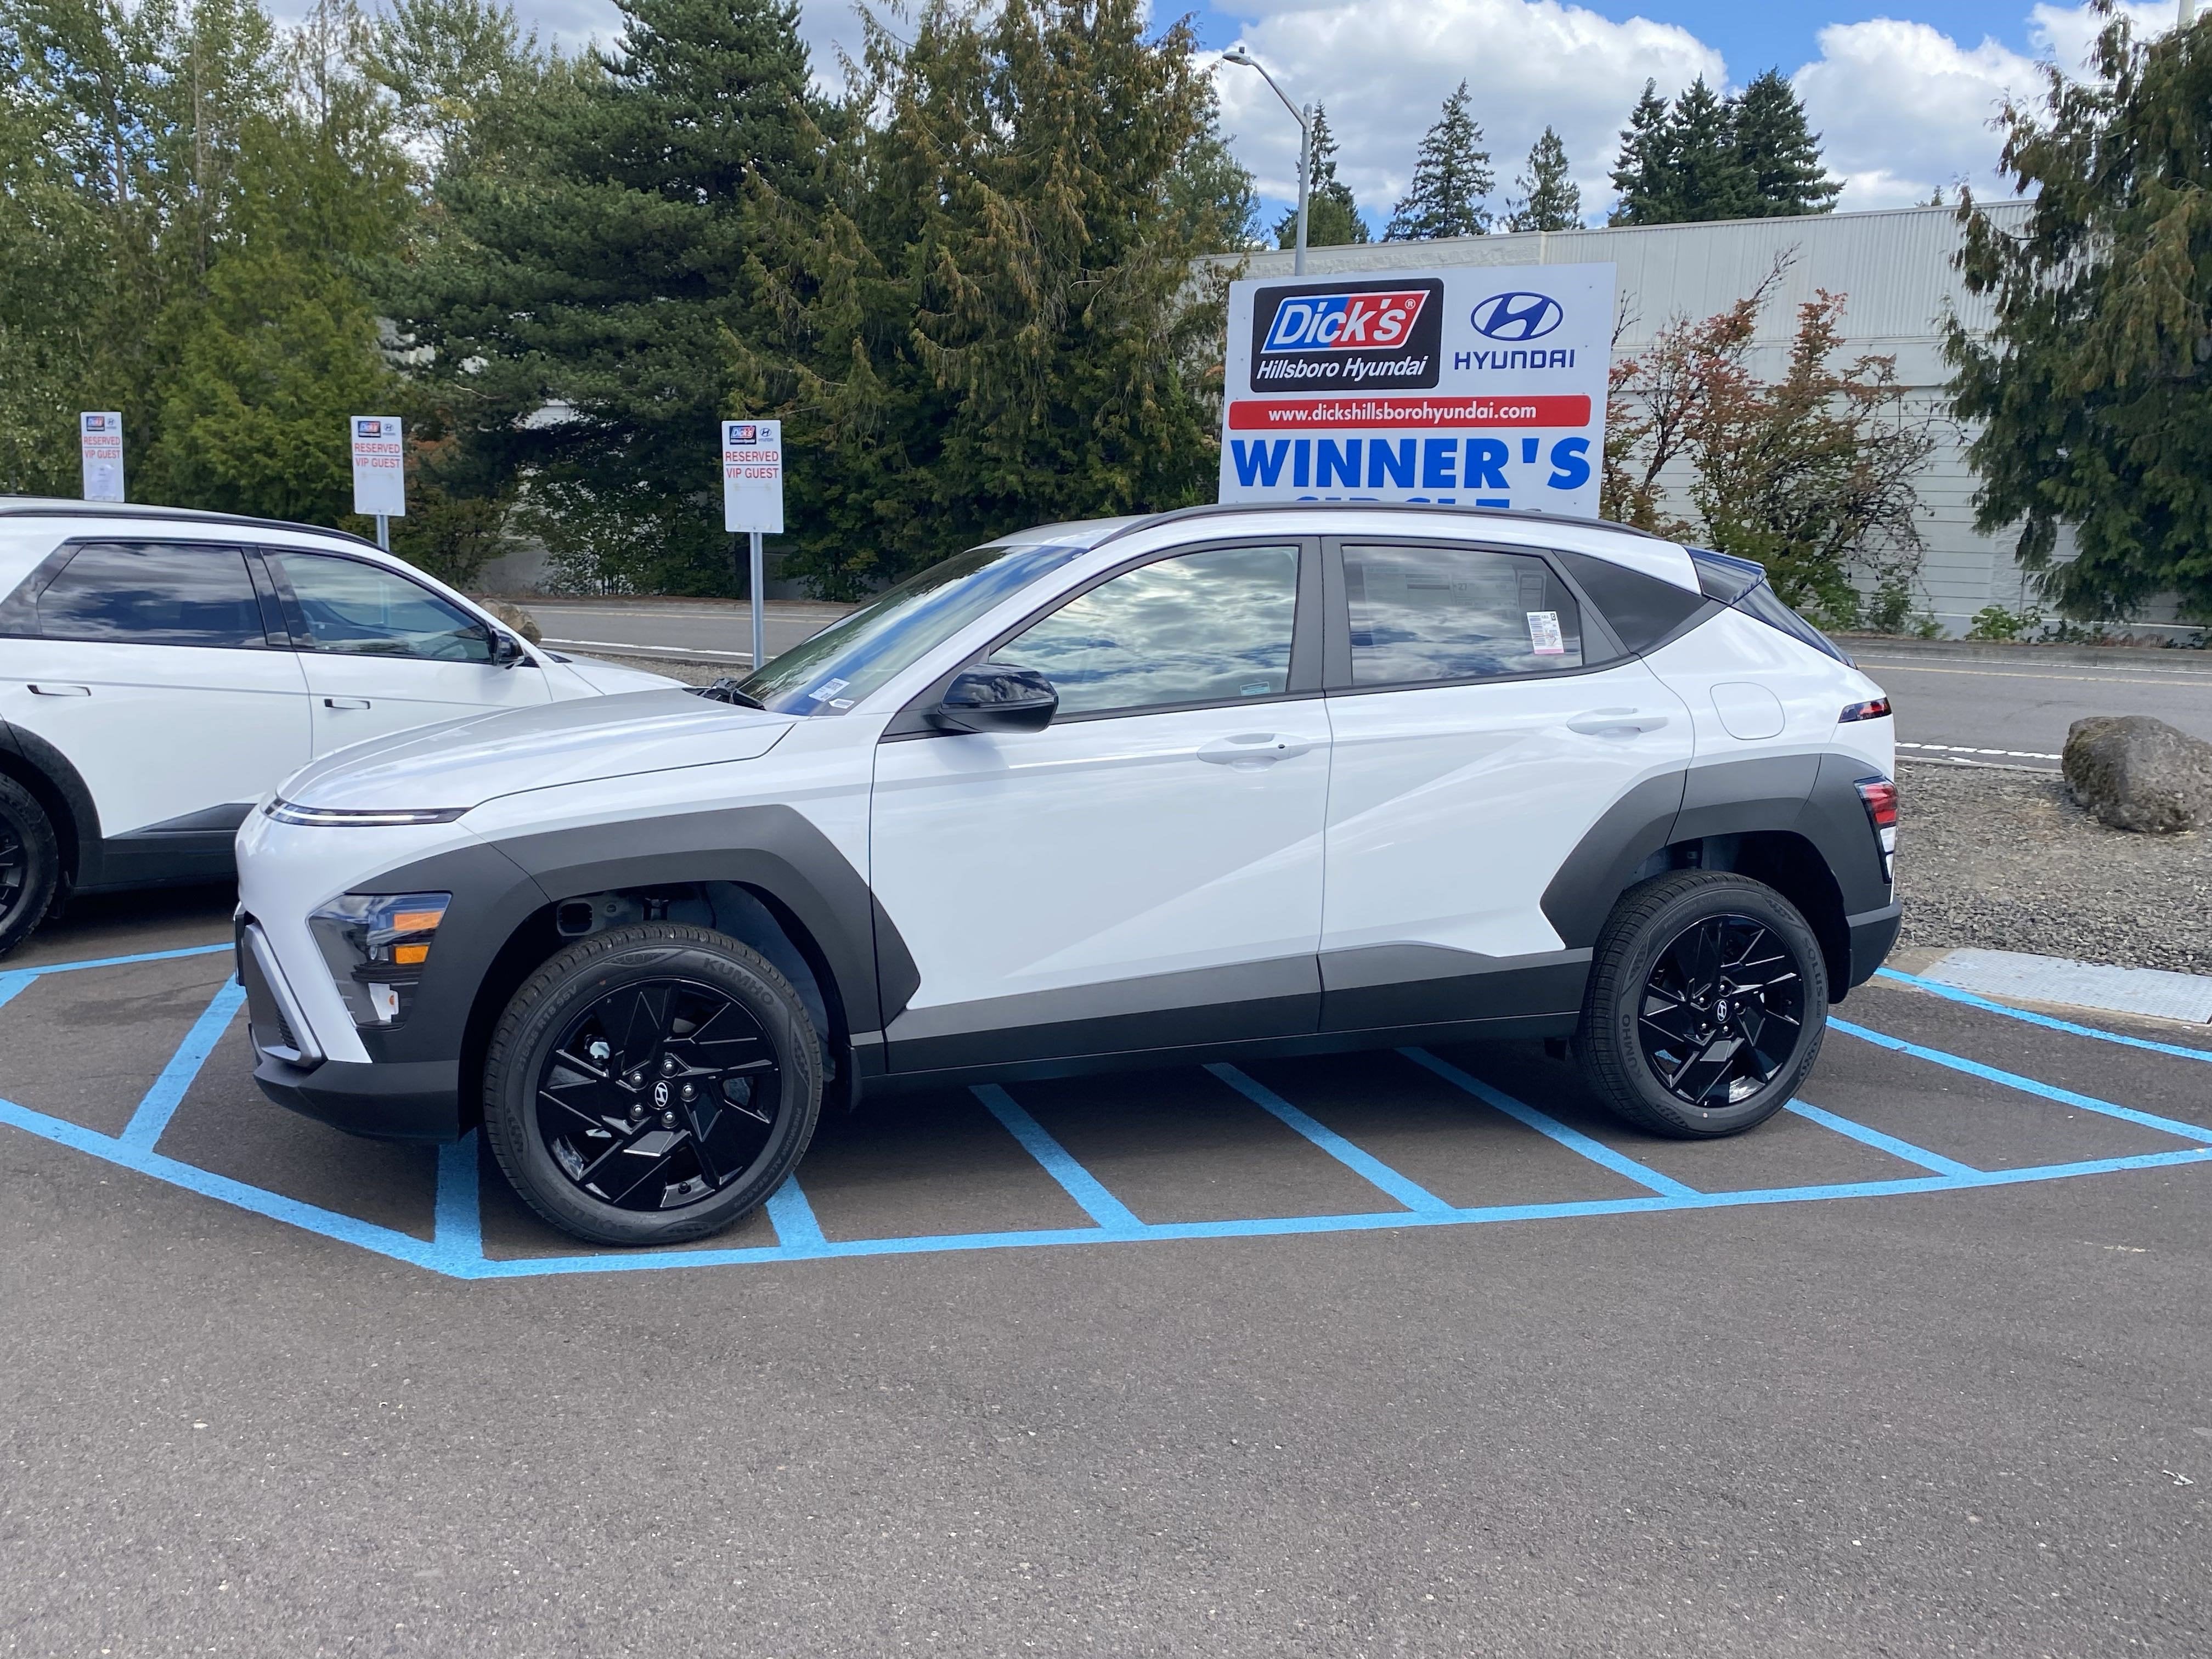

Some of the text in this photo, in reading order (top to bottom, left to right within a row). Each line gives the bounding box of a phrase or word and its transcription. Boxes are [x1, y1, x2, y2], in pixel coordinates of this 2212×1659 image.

[1257, 356, 1429, 381] Hillsboro Hyundai
[1454, 349, 1575, 370] HYUNDAI
[1268, 401, 1537, 424] www.dickshillsborohyundai.com
[84, 436, 120, 445] RESERVED
[354, 443, 400, 453] RESERVED
[84, 449, 120, 459] VIP GUEST
[356, 458, 400, 468] VIP GUEST
[725, 451, 778, 461] RESERVED
[1231, 437, 1590, 489] WINNER'S
[726, 467, 778, 478] VIP GUEST
[1458, 583, 1467, 591] 27
[703, 957, 774, 1005] KUMHO
[537, 1005, 556, 1029] R18
[556, 984, 577, 1007] 95V
[1622, 1014, 1643, 1080] KUMHO
[782, 1107, 802, 1156] PREMIUM
